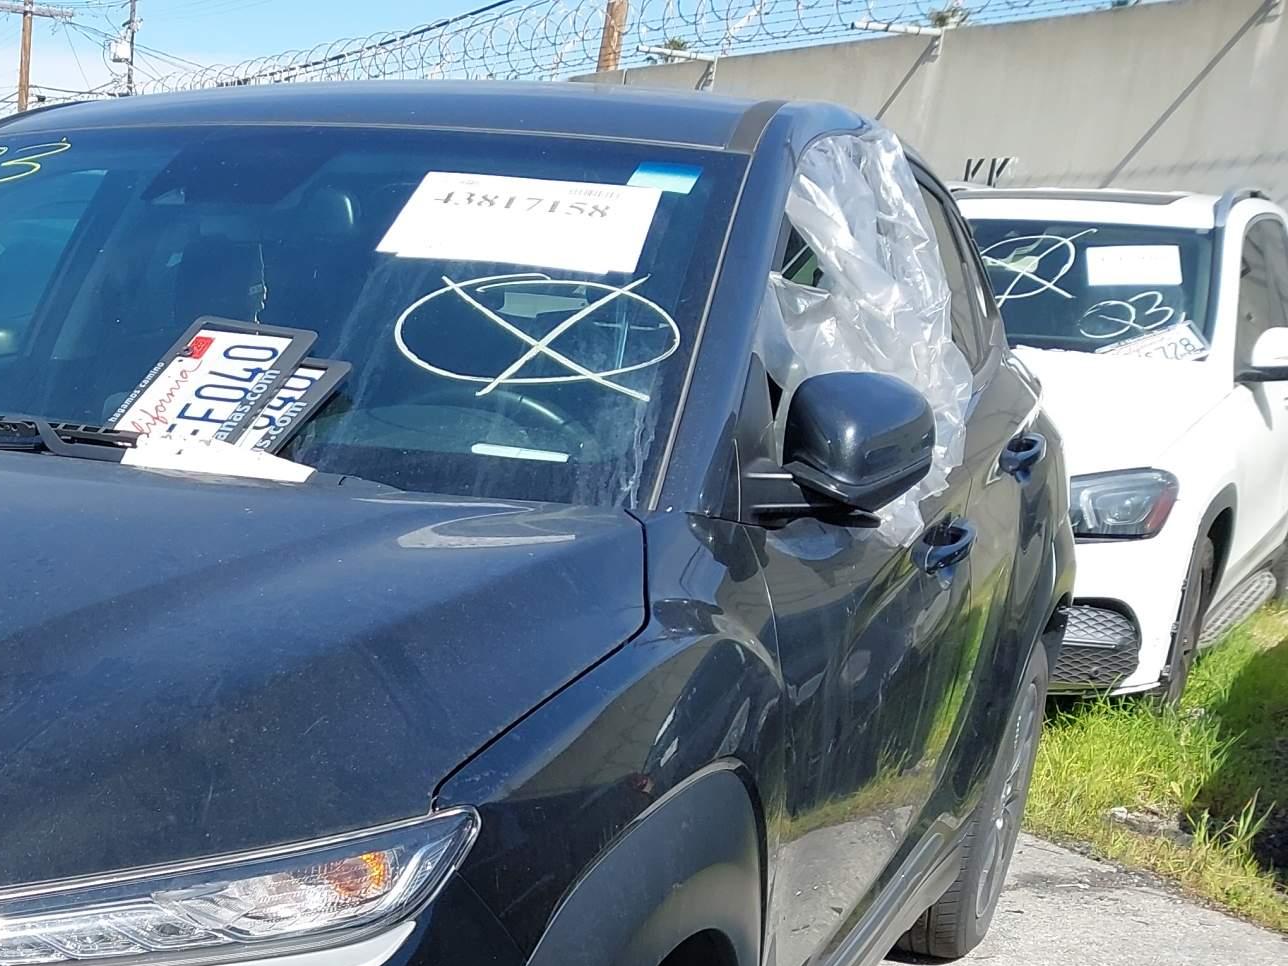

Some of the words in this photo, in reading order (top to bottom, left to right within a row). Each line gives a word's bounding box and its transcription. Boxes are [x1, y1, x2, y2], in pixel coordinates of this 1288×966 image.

[433, 190, 612, 219] 43817158
[108, 387, 140, 423] hagamos
[139, 361, 165, 388] camino
[130, 360, 203, 436] lifornia
[215, 368, 281, 442] anas.com
